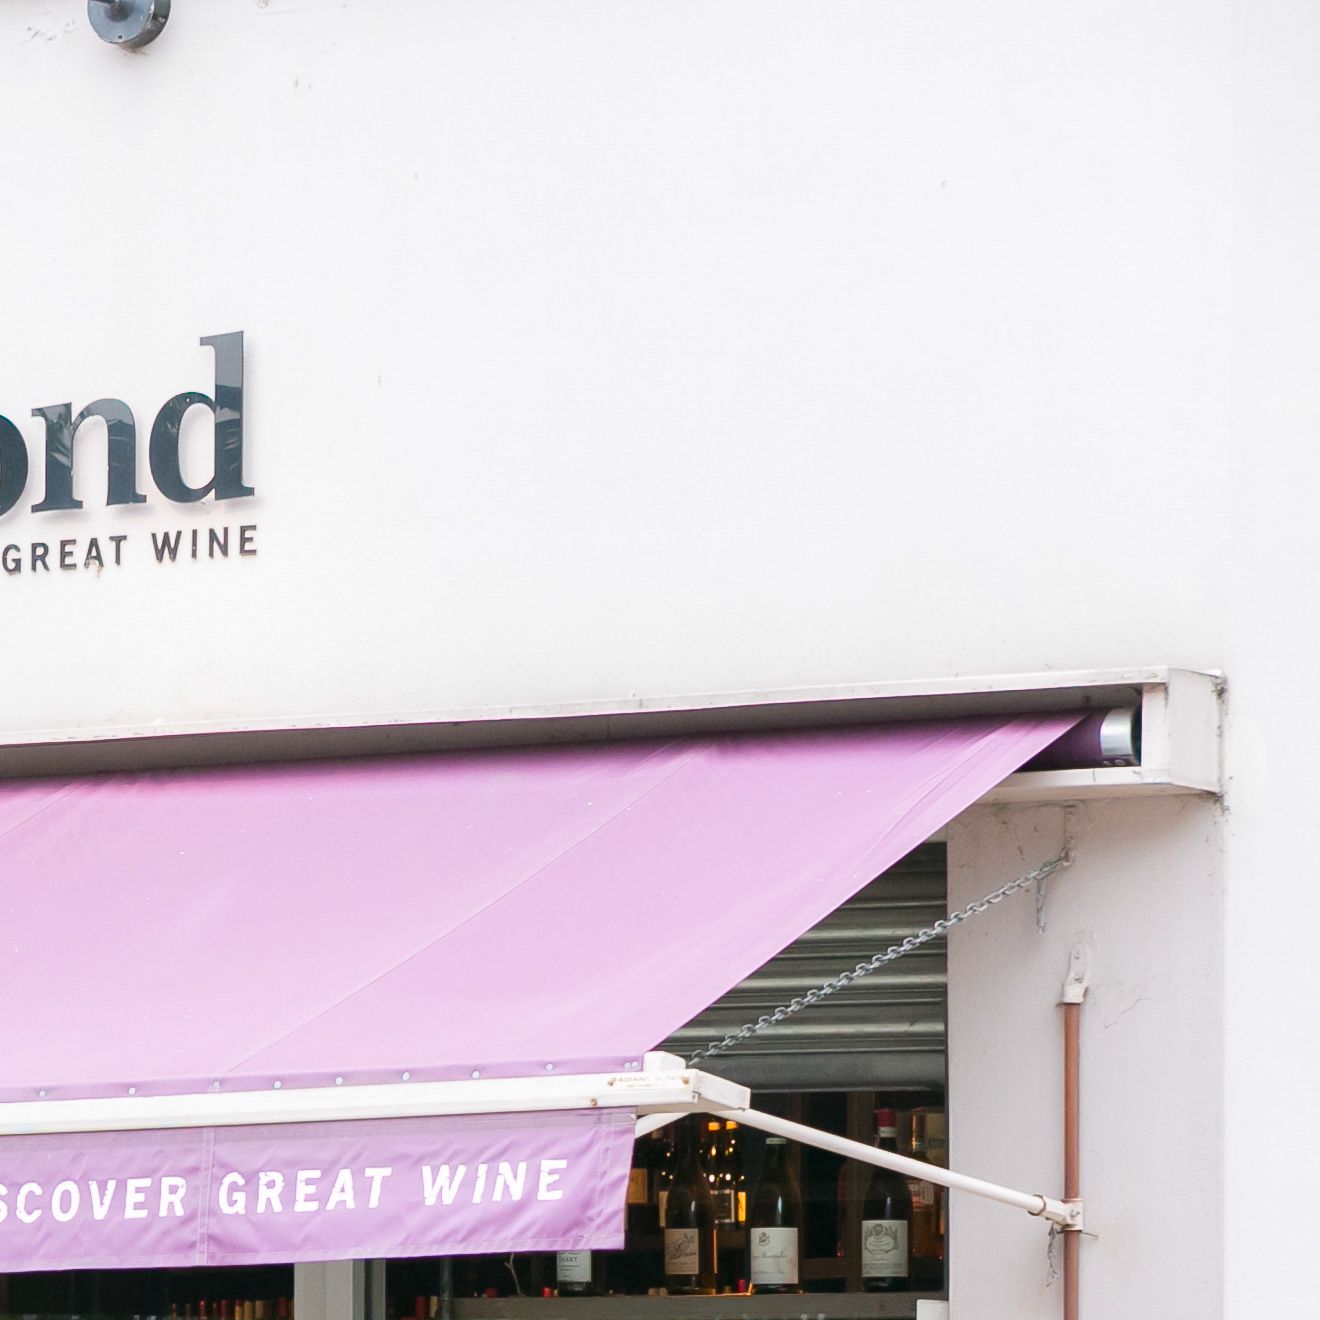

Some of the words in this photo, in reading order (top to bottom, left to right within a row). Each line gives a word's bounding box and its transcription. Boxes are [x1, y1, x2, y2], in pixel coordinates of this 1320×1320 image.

[2, 536, 128, 577] GREAT
[152, 523, 259, 565] WINE
[218, 1165, 393, 1216] GREAT
[420, 1158, 569, 1206] WINE
